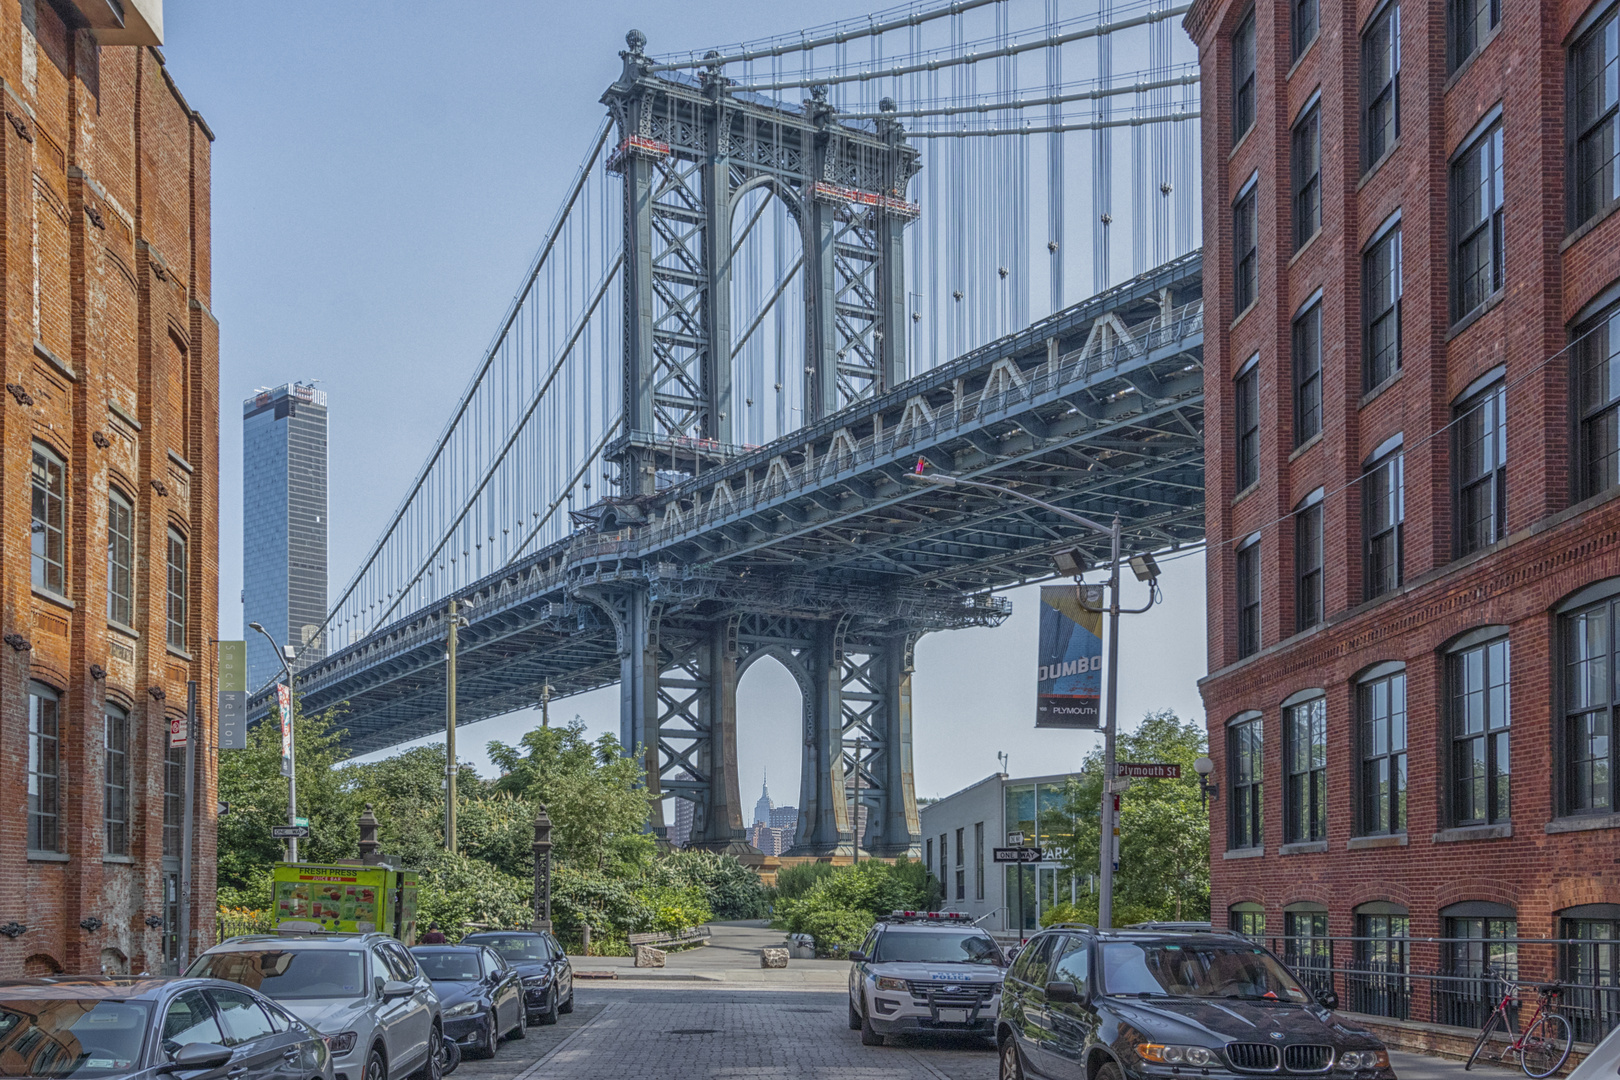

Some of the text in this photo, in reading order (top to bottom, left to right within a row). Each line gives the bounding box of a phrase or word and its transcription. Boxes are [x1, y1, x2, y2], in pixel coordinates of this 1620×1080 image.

[1038, 655, 1102, 682] DUMBO
[225, 645, 235, 746] Smack Mellon
[1053, 707, 1098, 715] PLYMOUTH
[1119, 765, 1177, 777] Plymouth St
[1000, 851, 1035, 859] ONE WAY
[299, 867, 358, 877] FRESH PRESS
